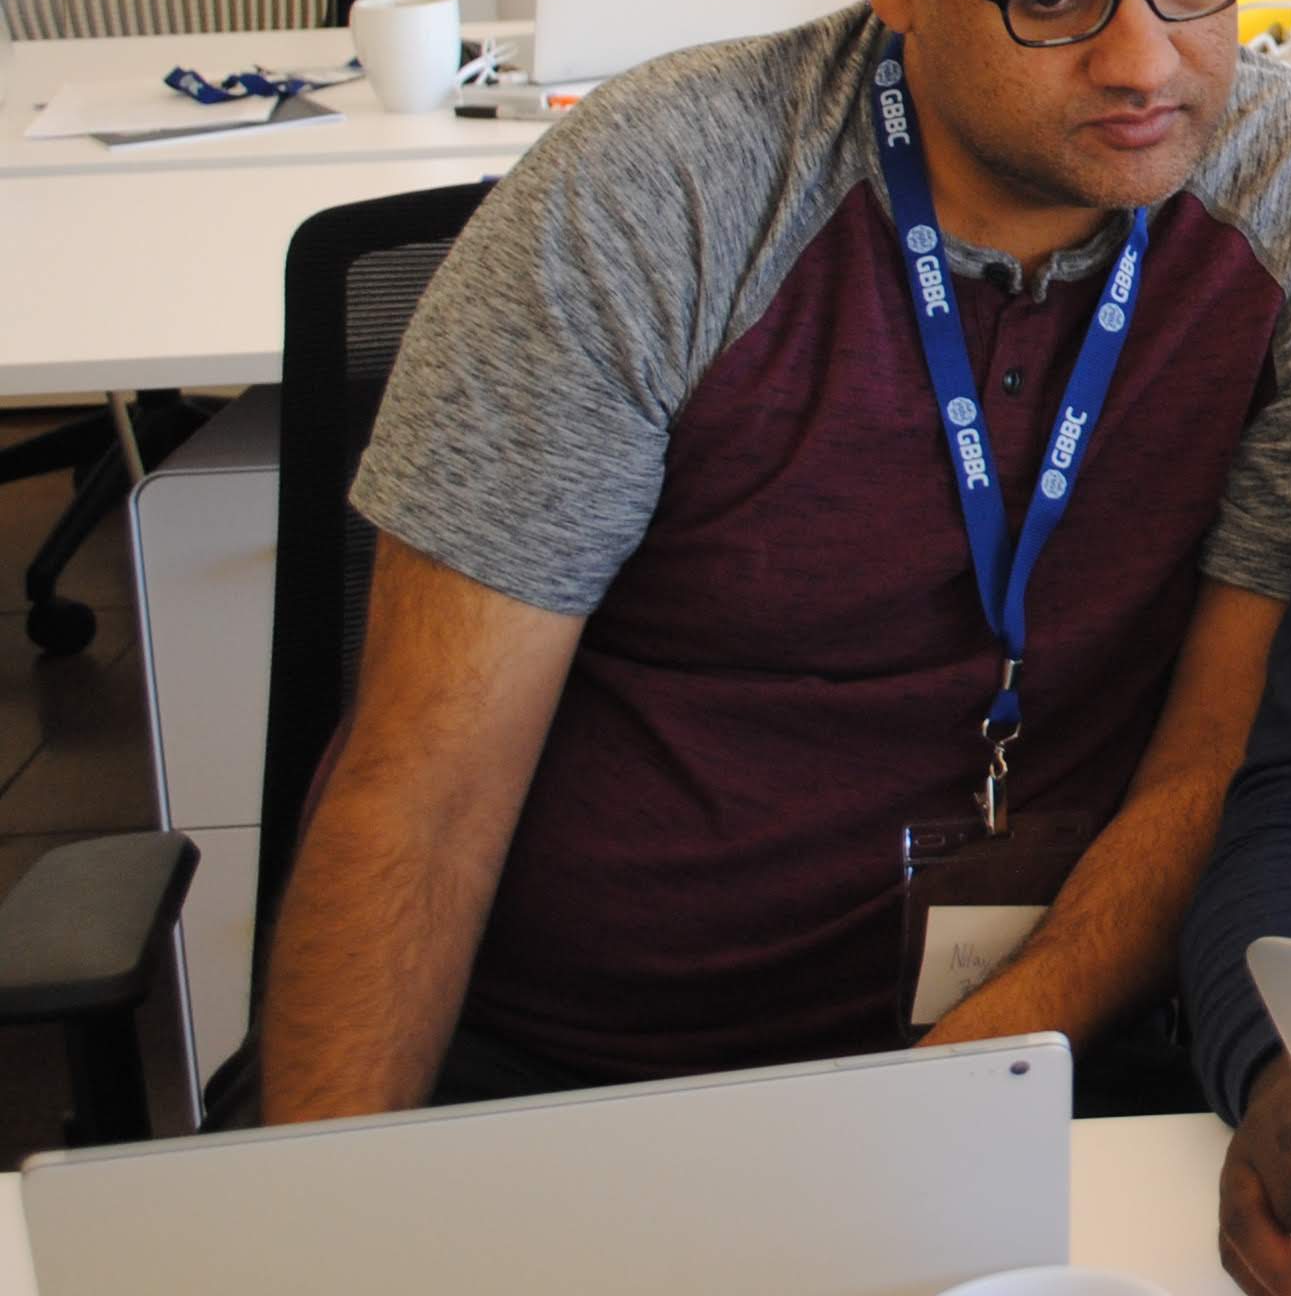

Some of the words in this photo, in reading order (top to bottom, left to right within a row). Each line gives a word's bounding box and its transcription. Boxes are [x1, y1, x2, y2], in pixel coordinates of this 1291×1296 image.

[881, 88, 910, 148] GBBC
[915, 253, 950, 317] GBBC
[1110, 245, 1139, 305] GBBC
[956, 426, 989, 491] GBBC
[1051, 405, 1088, 471] GBBC
